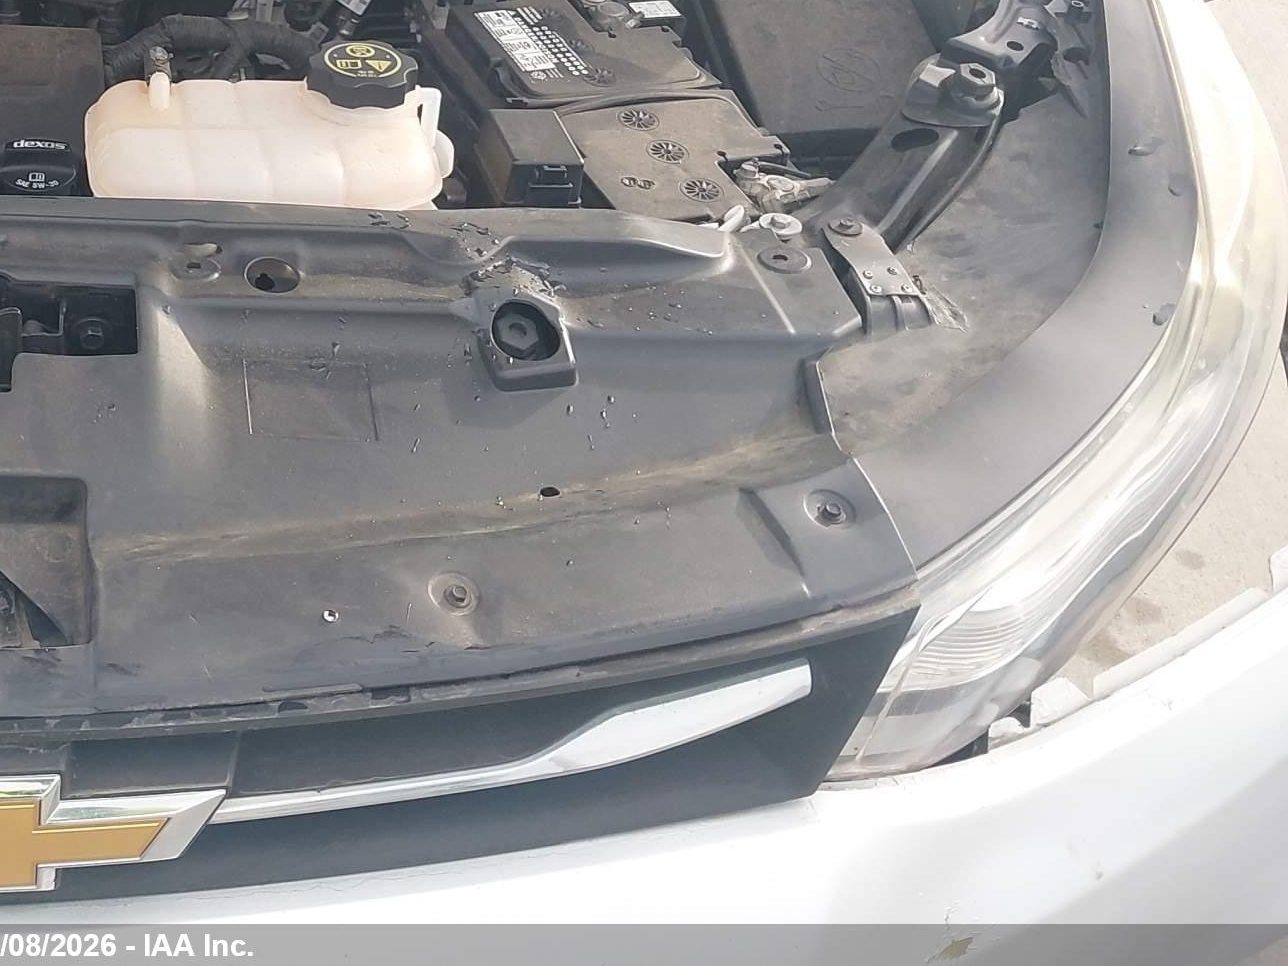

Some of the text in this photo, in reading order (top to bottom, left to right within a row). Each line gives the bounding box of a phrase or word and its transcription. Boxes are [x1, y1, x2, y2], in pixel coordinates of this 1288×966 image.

[13, 139, 67, 150] dexos
[15, 178, 60, 189] SAE 5W-30
